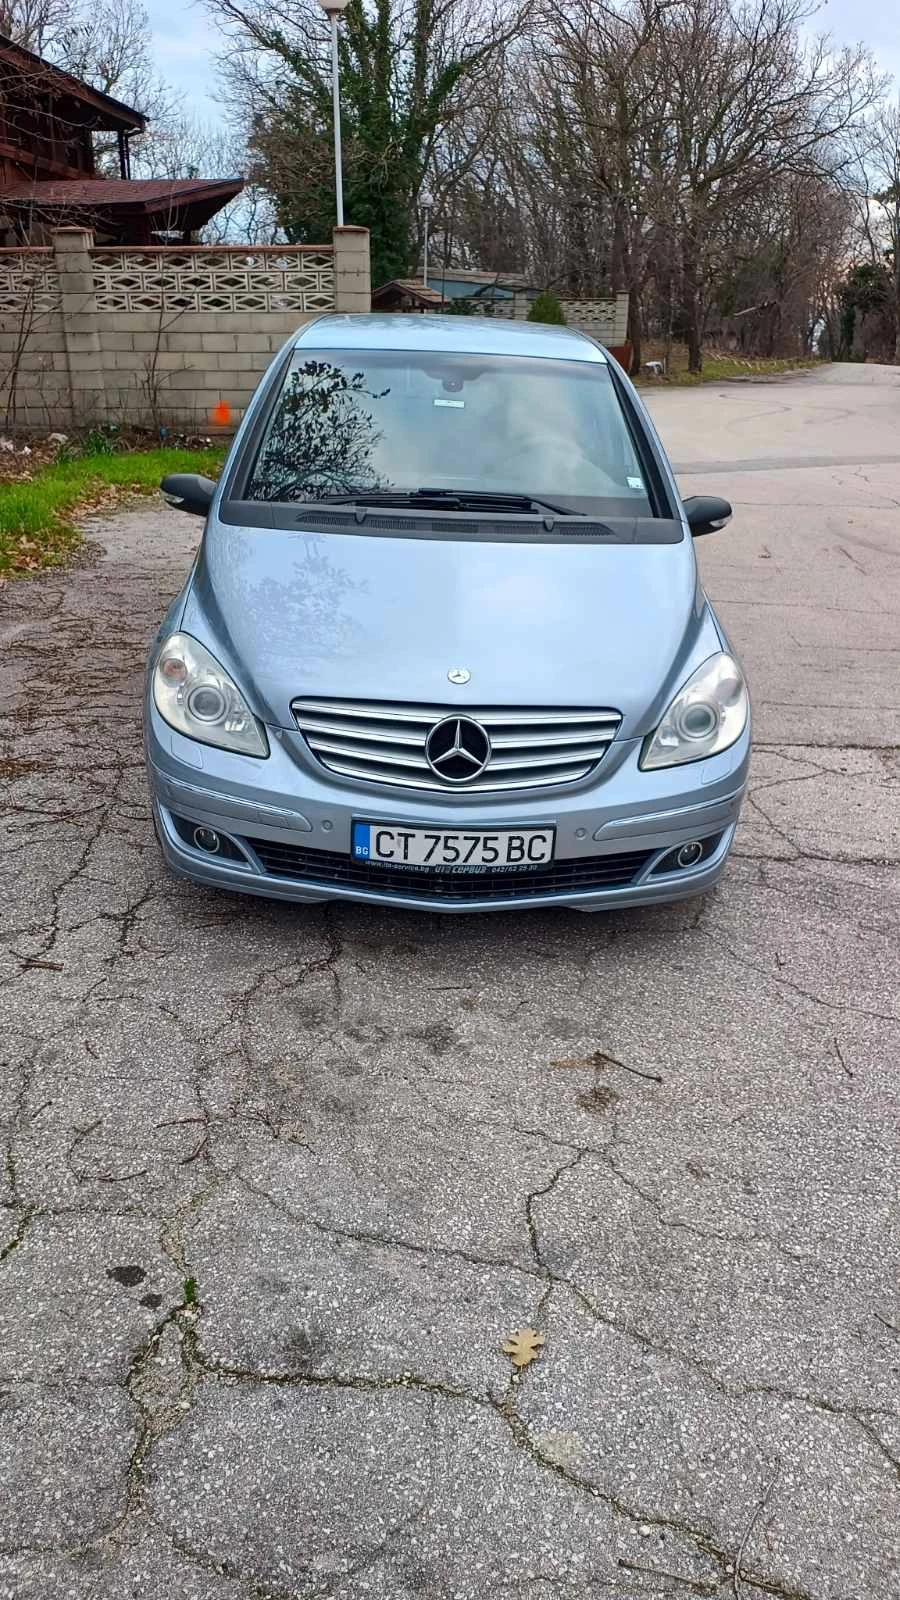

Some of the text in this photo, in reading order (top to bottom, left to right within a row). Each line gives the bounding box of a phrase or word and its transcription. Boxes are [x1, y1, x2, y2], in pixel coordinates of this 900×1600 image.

[355, 845, 369, 856] BG
[375, 830, 547, 864] CT 7575 BC
